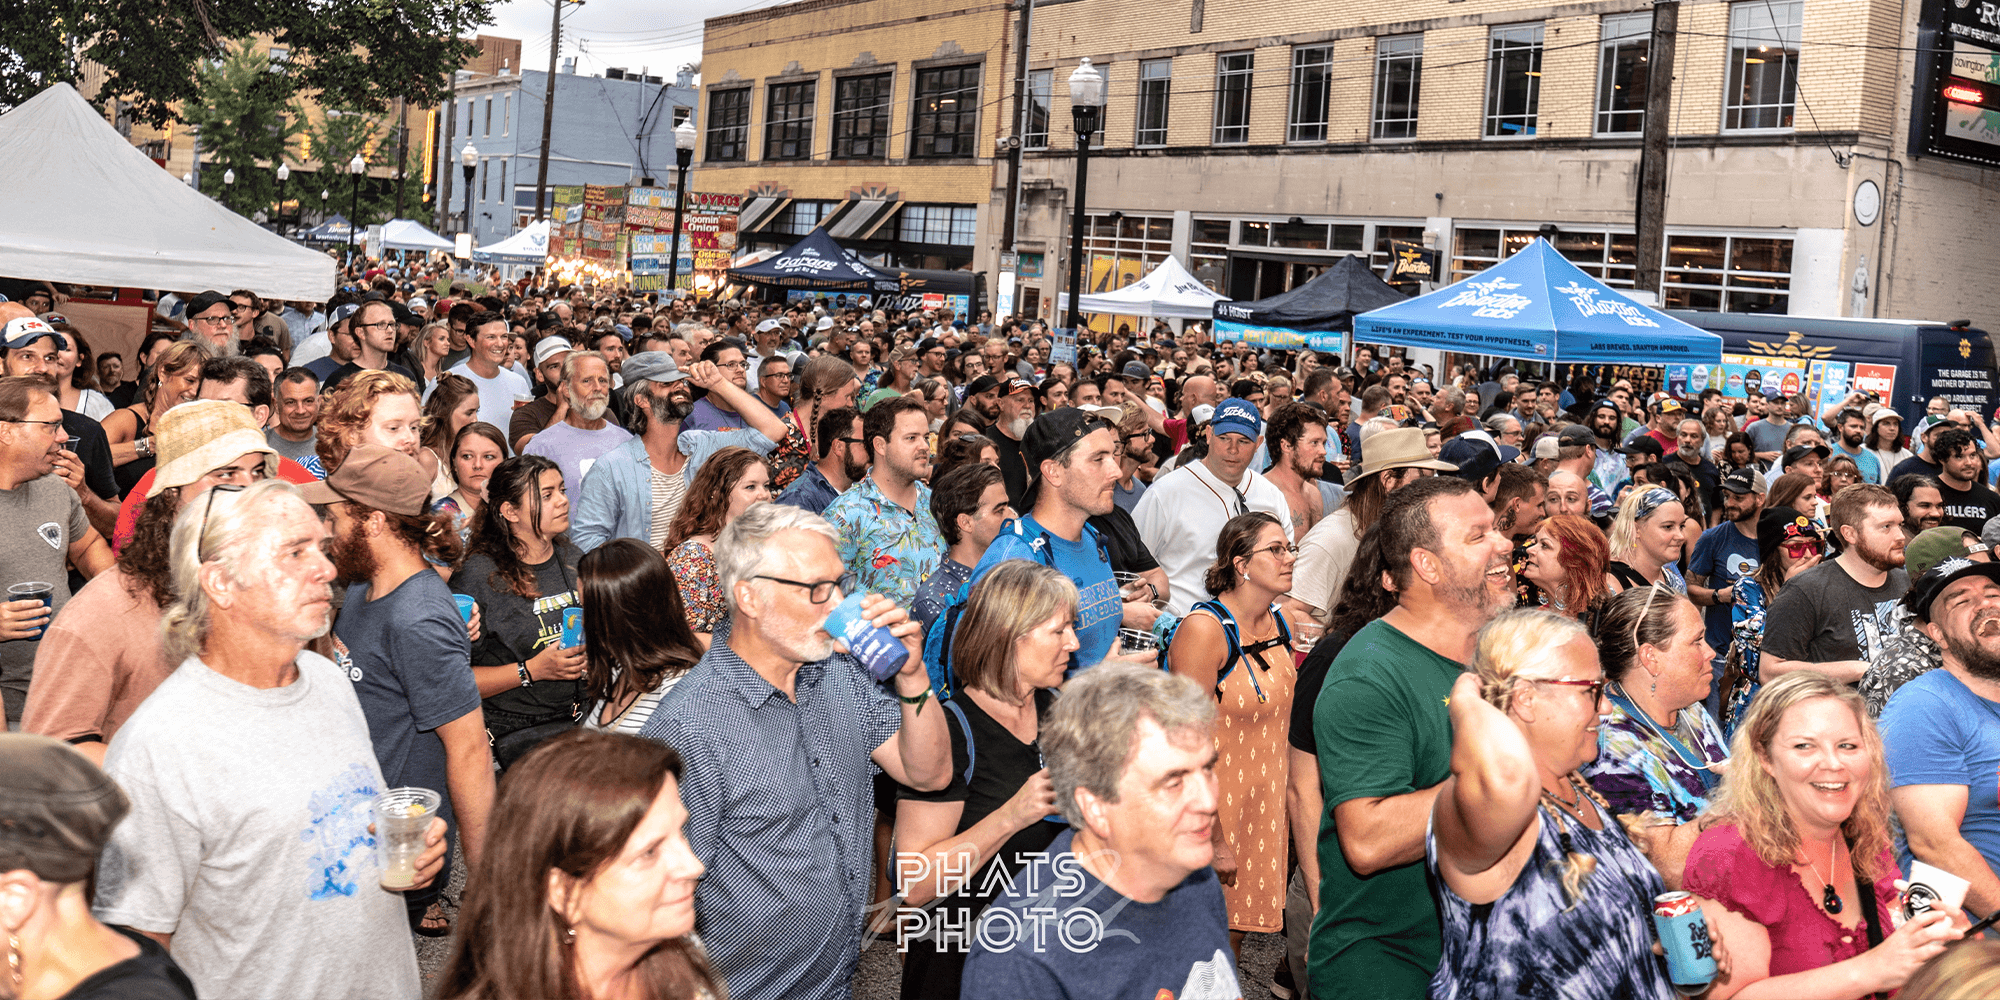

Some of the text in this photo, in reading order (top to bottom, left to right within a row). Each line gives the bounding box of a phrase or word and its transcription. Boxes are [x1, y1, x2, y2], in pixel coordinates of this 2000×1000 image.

[1954, 57, 1985, 73] covington
[652, 189, 677, 198] SQUEEZ
[700, 193, 740, 207] GYROS
[684, 214, 721, 224] Bloomin'
[688, 223, 720, 232] Onion
[632, 242, 691, 253] LEMONDE
[1396, 258, 1431, 274] Braxton
[633, 274, 692, 291] FUNNEL AKE
[1229, 306, 1254, 320] HOIST
[1569, 296, 1646, 319] Braxton
[1371, 326, 1392, 334] LIFE'S
[1402, 328, 1446, 338] EXPERIMENT.
[1448, 332, 1464, 340] TEST
[1464, 333, 1484, 342] YOUR
[1485, 336, 1532, 348] HYPOTHESIS.
[1828, 368, 1844, 380] $10
[1938, 369, 1988, 380] THE GARAGE IS THE
[1856, 376, 1891, 392] PUNCH
[1932, 379, 1958, 388] MOTHER
[1958, 380, 1966, 388] OF
[1952, 394, 1974, 403] AROUND
